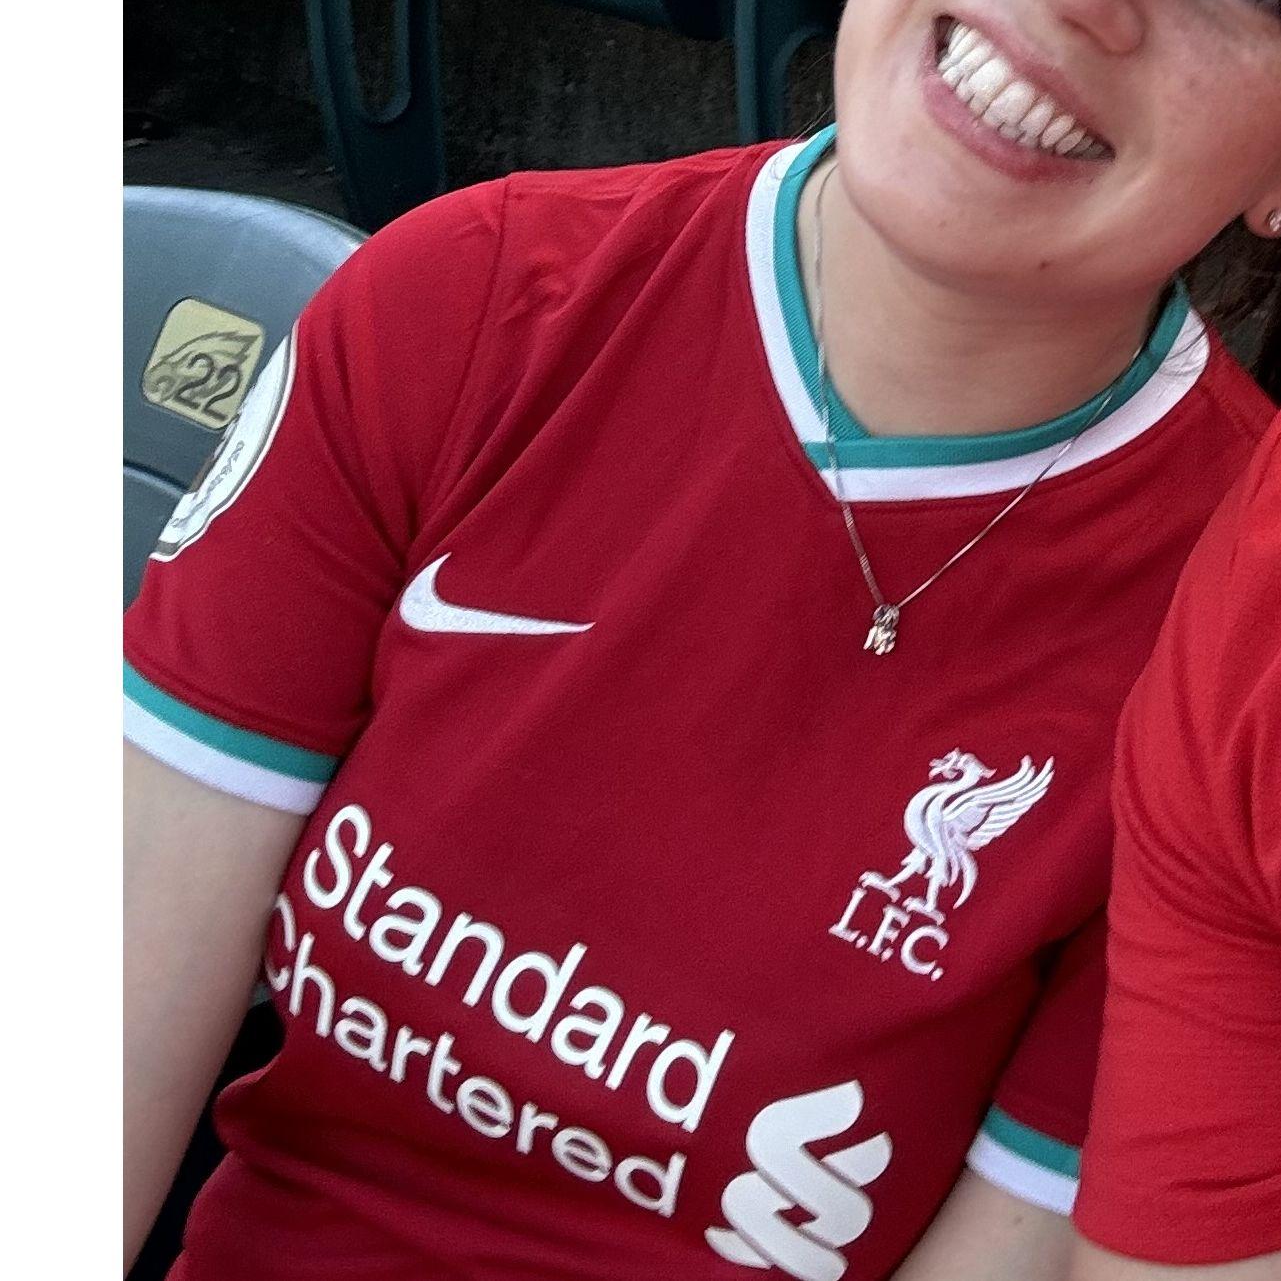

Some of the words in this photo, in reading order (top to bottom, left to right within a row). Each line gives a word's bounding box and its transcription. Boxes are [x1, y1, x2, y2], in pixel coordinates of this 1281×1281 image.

[175, 352, 243, 421] 22
[304, 804, 736, 1134] Standard
[828, 887, 950, 982] L.F.C.
[265, 892, 687, 1218] Chartered
